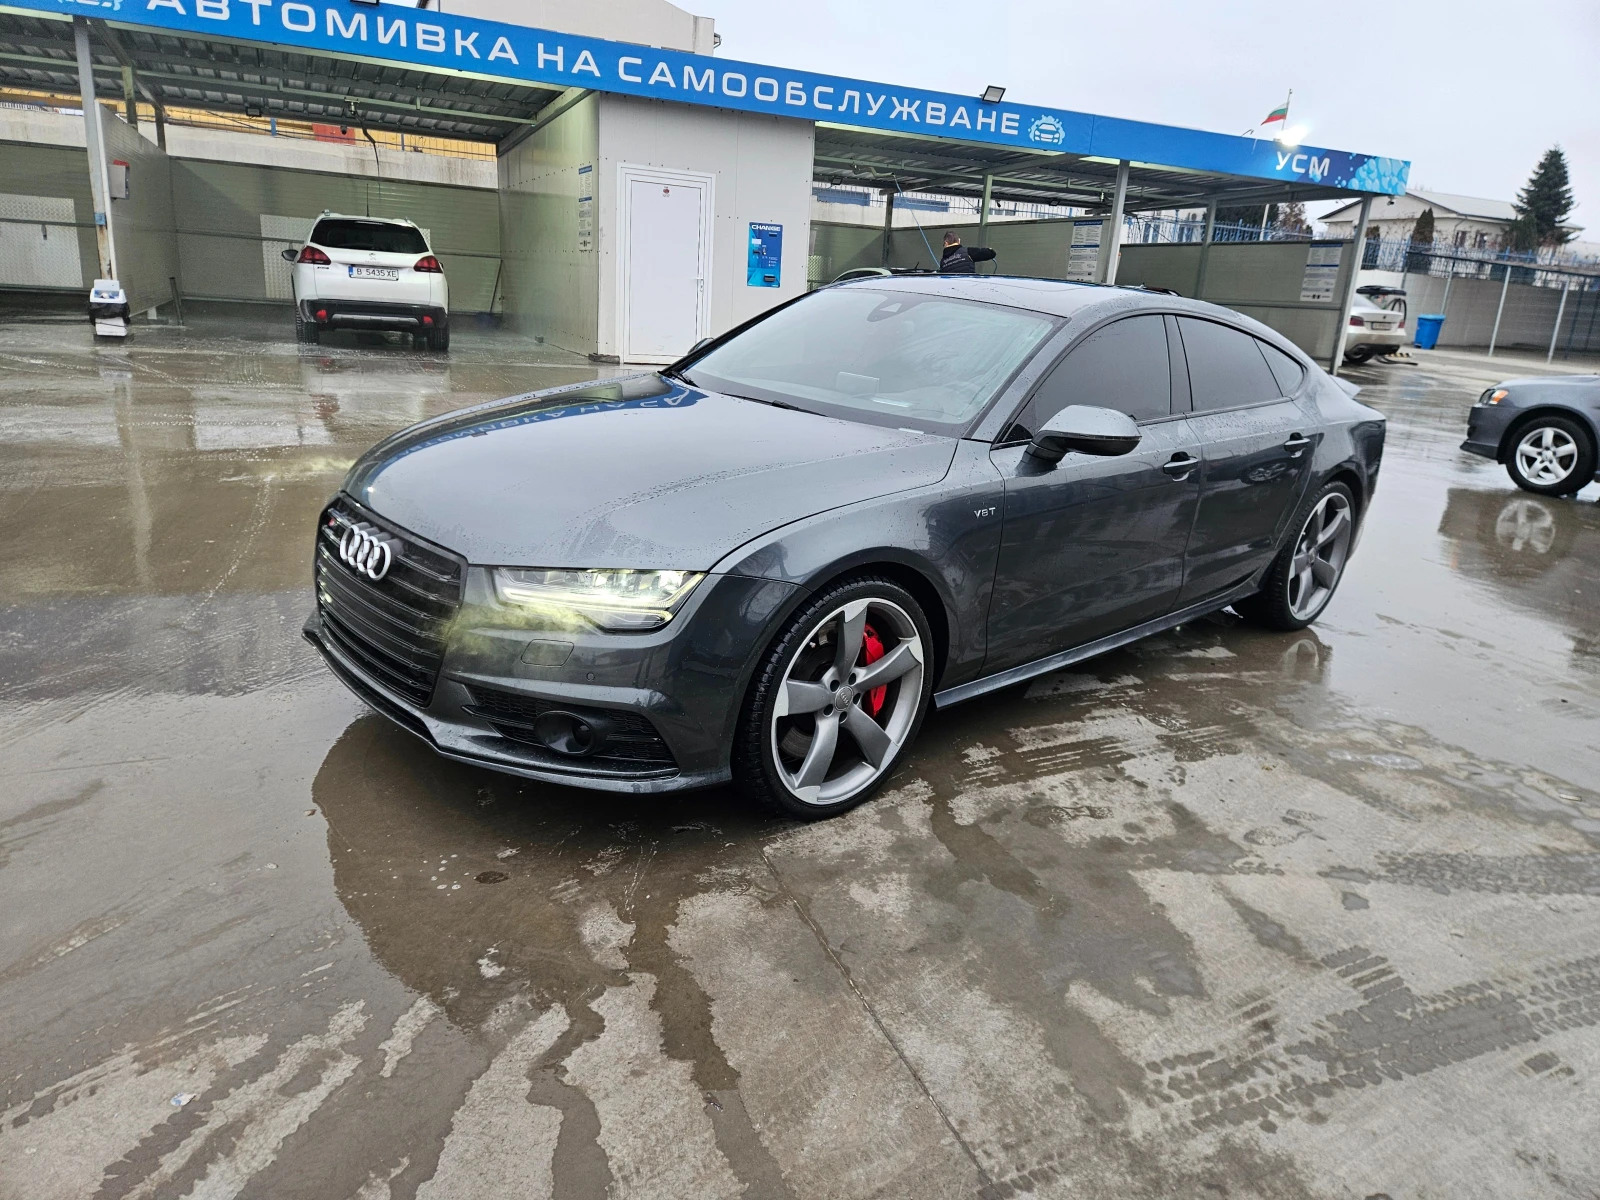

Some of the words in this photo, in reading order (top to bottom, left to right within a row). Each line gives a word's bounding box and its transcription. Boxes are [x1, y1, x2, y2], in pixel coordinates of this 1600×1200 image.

[147, 0, 519, 65] АВТОМИВКА
[537, 42, 601, 77] НА
[617, 56, 1021, 136] САМООБСЛУЖВАНЕ
[1275, 151, 1331, 177] УСМ
[973, 506, 996, 519] V8T
